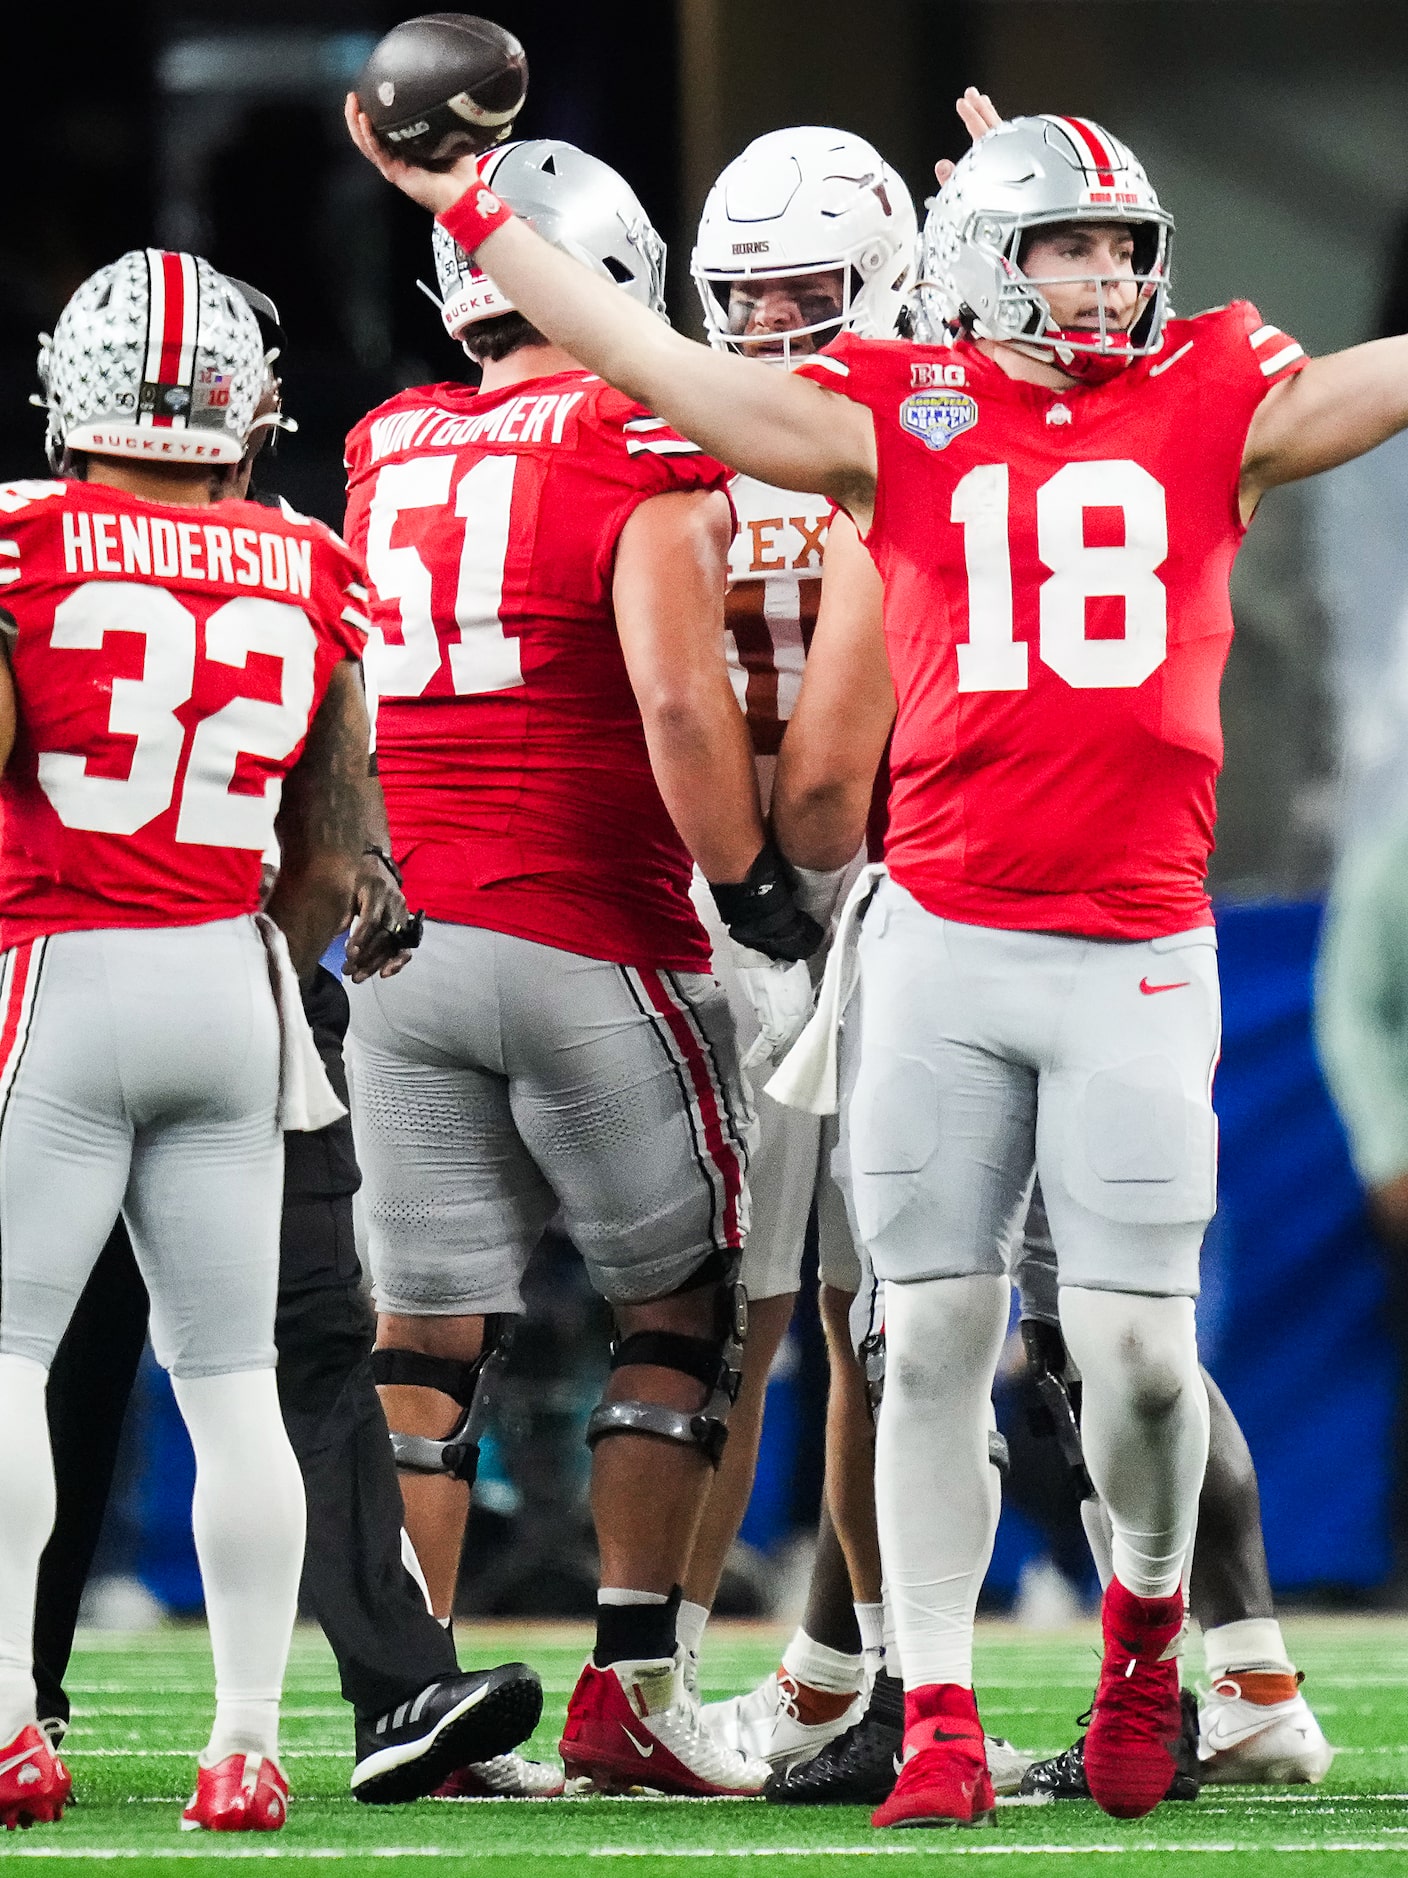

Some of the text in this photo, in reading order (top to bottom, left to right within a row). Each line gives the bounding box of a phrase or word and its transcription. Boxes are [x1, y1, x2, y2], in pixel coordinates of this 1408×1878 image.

[92, 434, 222, 457] BUCKEYES
[370, 391, 584, 465] MONTGOMERY
[907, 405, 971, 427] COTTON
[62, 511, 312, 600] HENDERSON
[362, 453, 527, 697] 51
[727, 515, 830, 573] EX
[949, 459, 1169, 693] 18
[37, 579, 319, 851] 32
